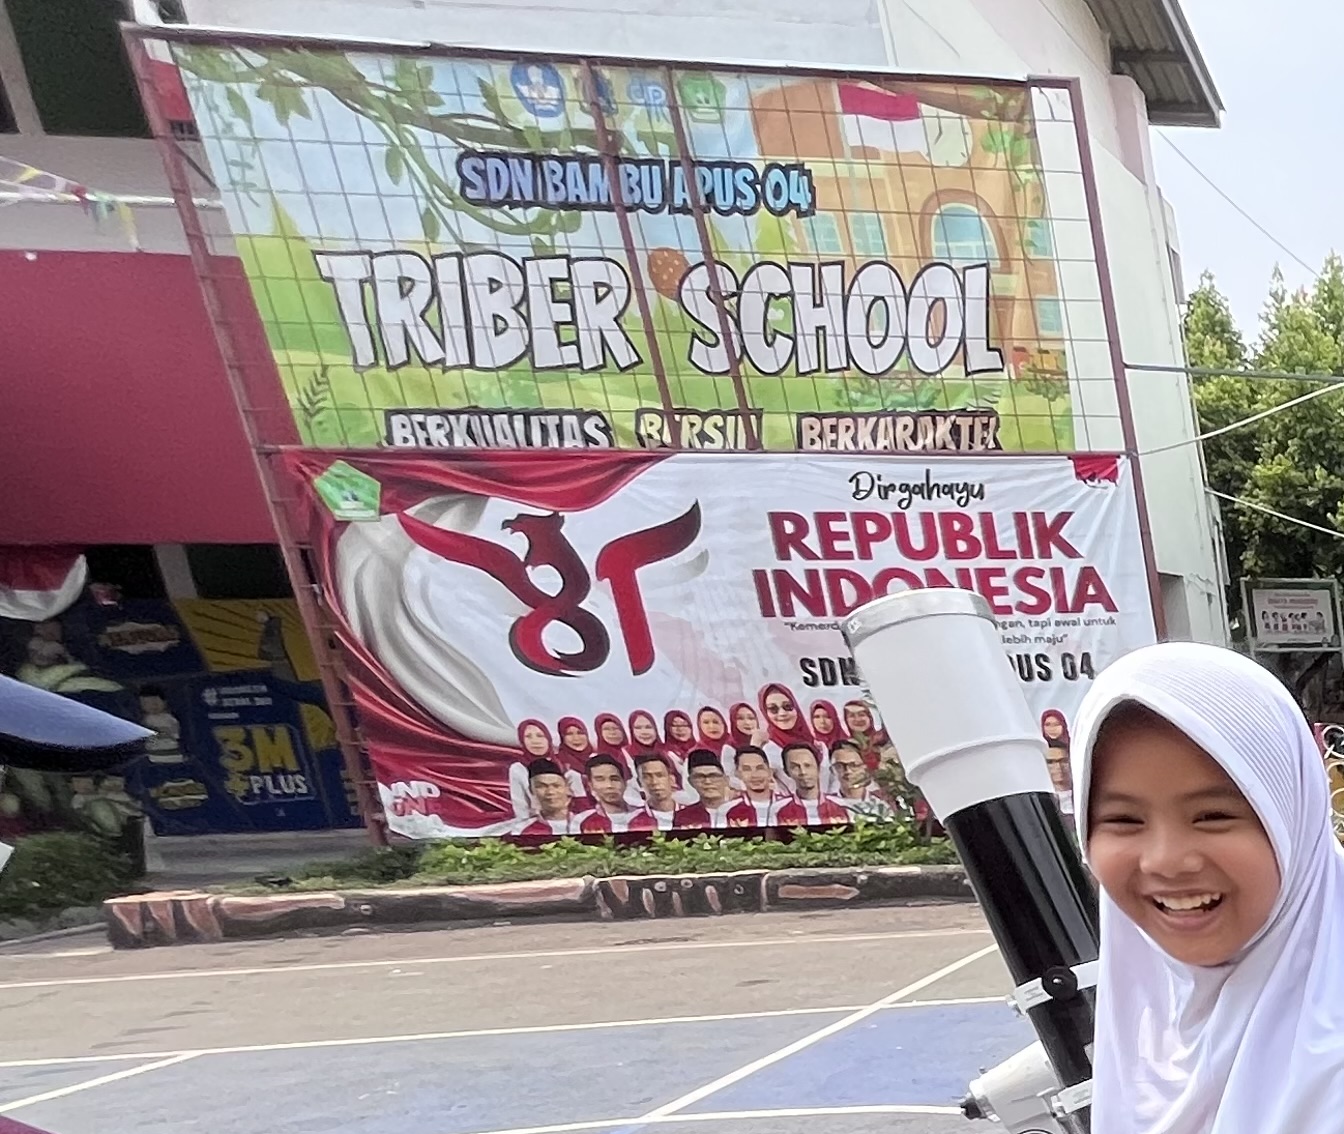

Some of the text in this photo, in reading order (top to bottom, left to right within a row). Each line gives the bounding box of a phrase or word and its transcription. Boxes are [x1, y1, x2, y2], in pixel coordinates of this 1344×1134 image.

[460, 156, 813, 212] SDN BAMBU APUS 04
[312, 251, 1005, 377] TRIBER SCHOOL
[849, 469, 985, 509] Dirgahayu
[767, 511, 1084, 561] REPUBLIK
[752, 565, 1119, 618] INDESIA
[1001, 634, 1032, 644] lebih
[1028, 618, 1051, 630] tapi
[1054, 617, 1081, 628] awal
[1084, 616, 1117, 627] untuk
[1061, 651, 1096, 681] 04
[212, 725, 301, 774] 3M
